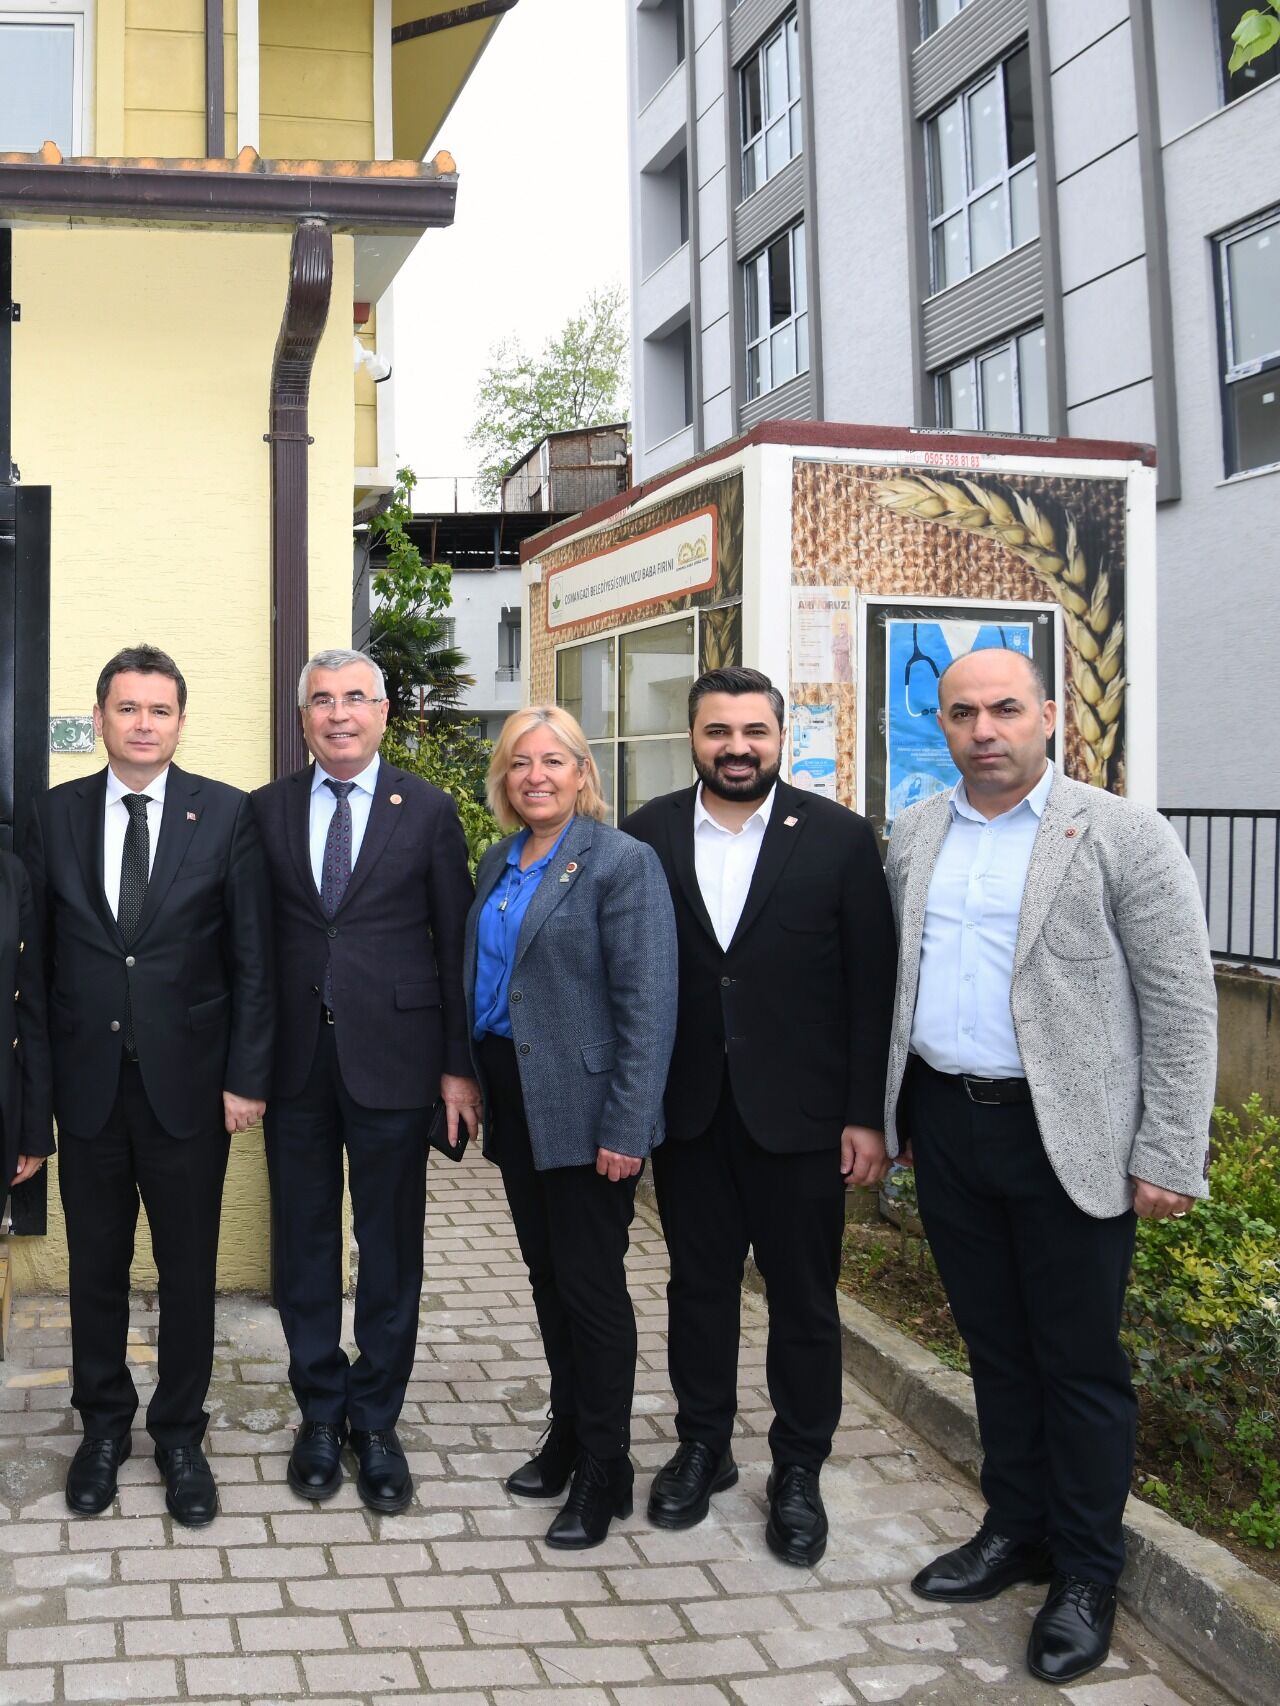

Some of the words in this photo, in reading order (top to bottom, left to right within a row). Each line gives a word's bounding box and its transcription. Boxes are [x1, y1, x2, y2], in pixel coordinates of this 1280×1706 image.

[590, 576, 616, 597] BELEDİYESİ
[615, 569, 642, 589] SOMUNCU
[642, 565, 657, 580] BABA
[657, 558, 674, 574] FIRINI
[65, 727, 77, 742] 3
